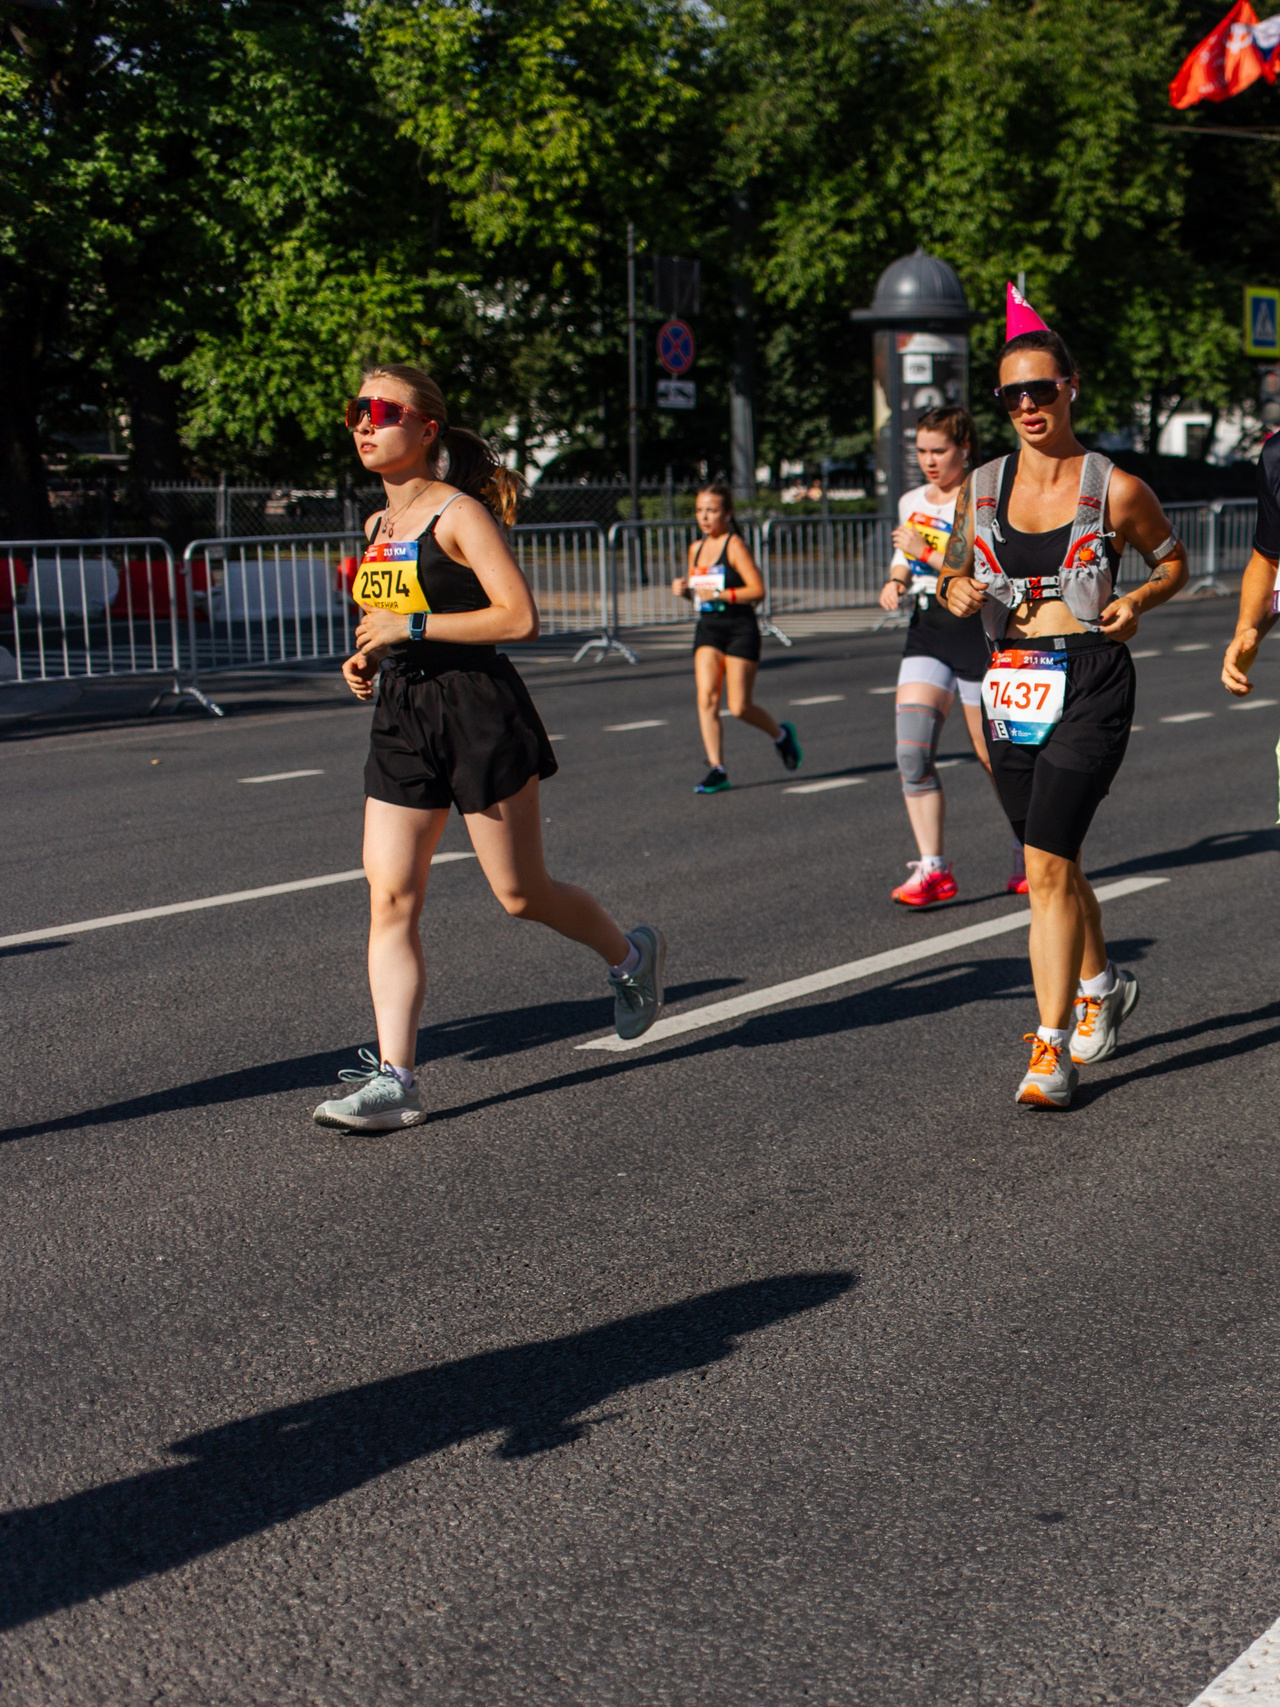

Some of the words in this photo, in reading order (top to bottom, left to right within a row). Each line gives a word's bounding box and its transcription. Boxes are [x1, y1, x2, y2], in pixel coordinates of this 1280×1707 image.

[360, 569, 410, 599] 2574
[1023, 656, 1038, 666] 21,1
[989, 681, 1051, 711] 7437
[997, 722, 1007, 736] E
